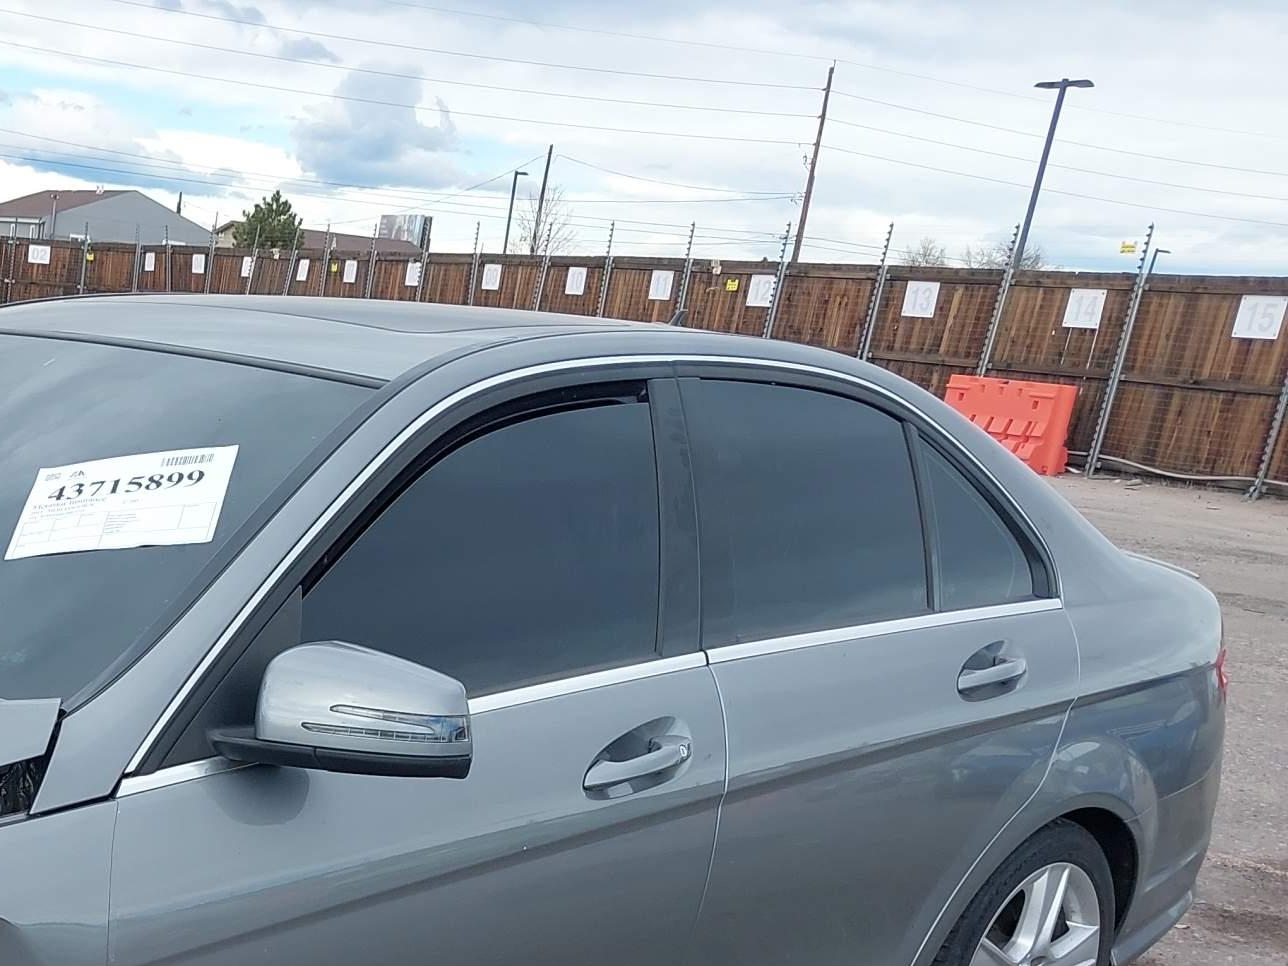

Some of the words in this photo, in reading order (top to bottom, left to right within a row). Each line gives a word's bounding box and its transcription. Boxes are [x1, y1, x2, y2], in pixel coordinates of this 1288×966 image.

[30, 246, 48, 262] 02
[571, 271, 584, 290] 10
[655, 274, 669, 296] 11
[754, 279, 772, 302] 12
[910, 286, 933, 311] 13
[1073, 295, 1099, 323] 14
[1244, 301, 1279, 333] 15
[48, 470, 205, 501] 43715899
